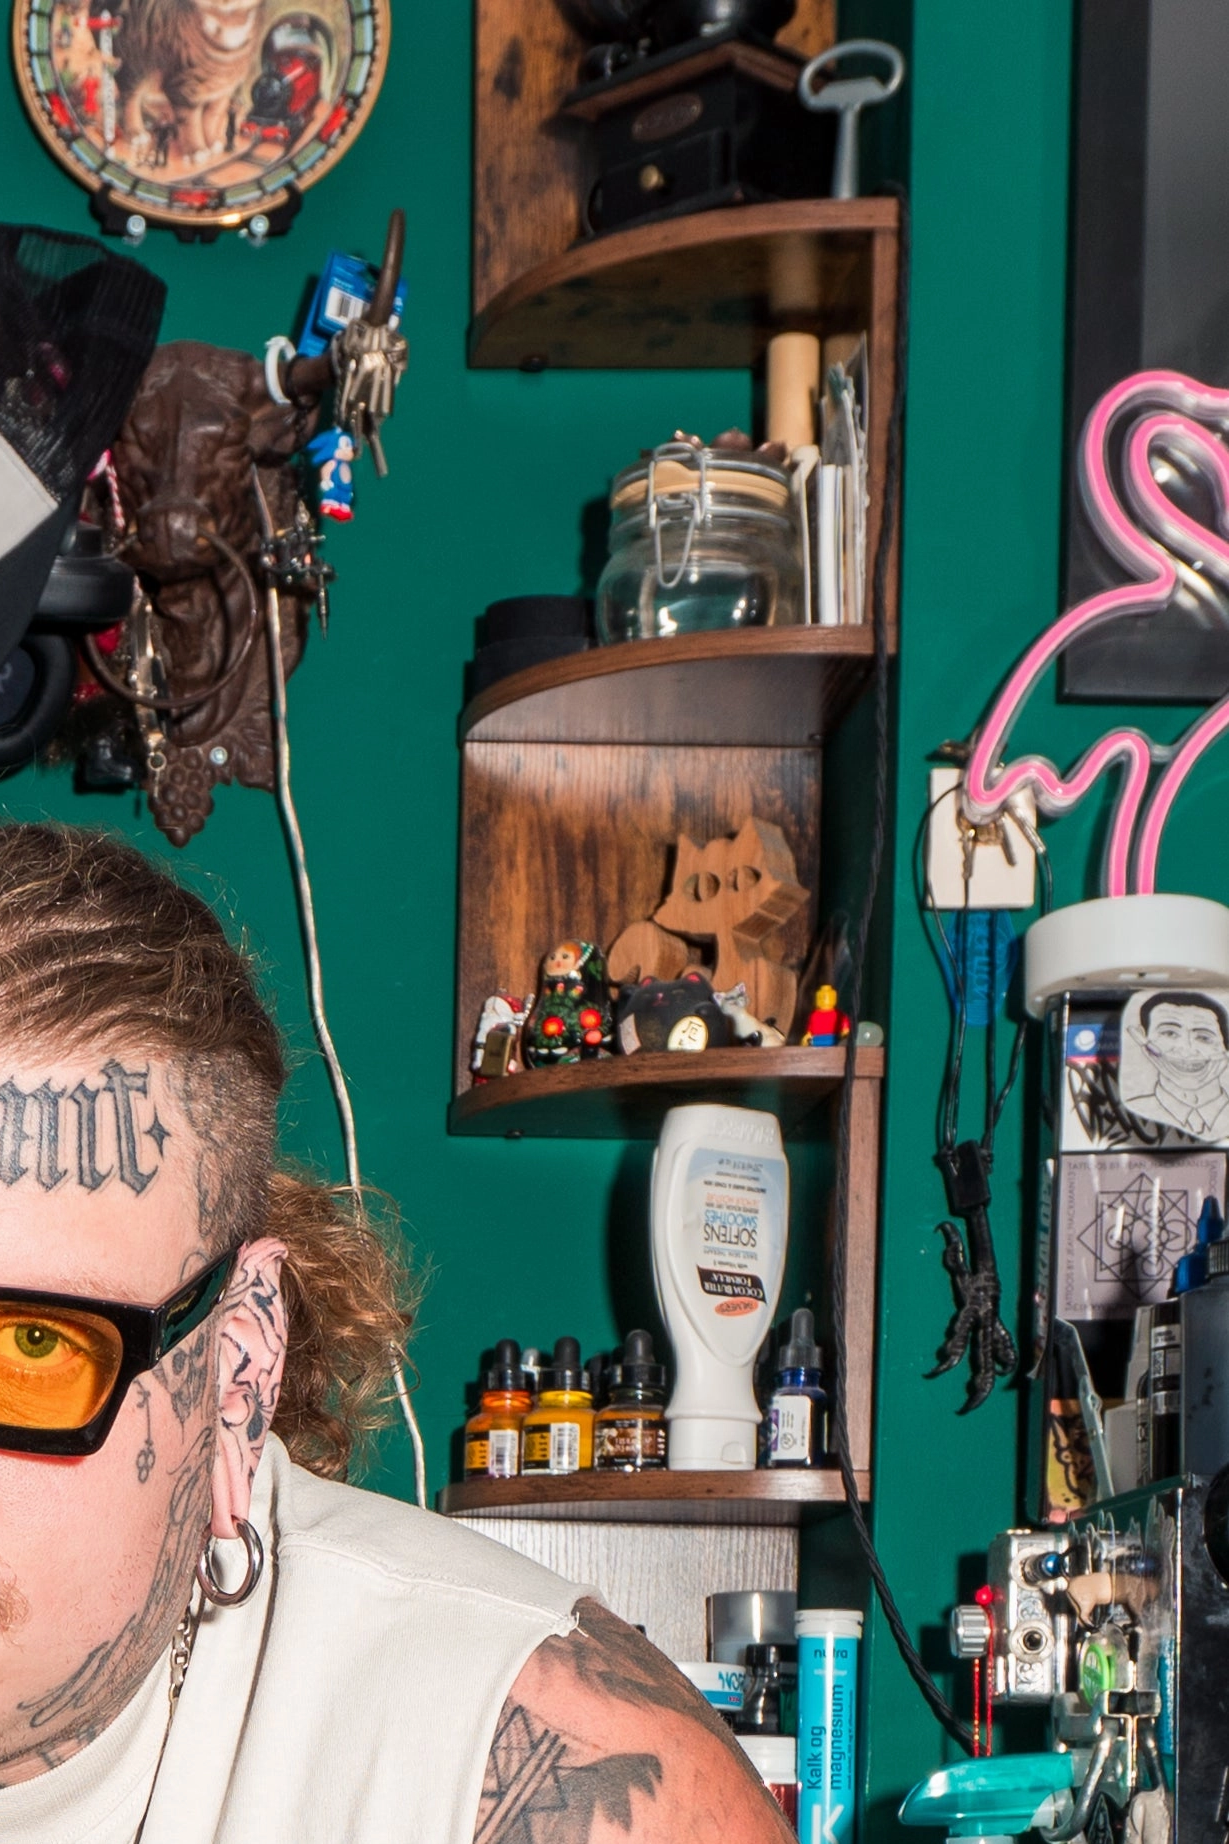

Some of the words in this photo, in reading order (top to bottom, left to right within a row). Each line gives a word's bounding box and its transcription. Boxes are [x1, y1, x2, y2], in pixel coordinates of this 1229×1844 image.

[703, 1222, 758, 1248] SOFTENS
[811, 1725, 827, 1749] og
[807, 1752, 823, 1790] Kalk
